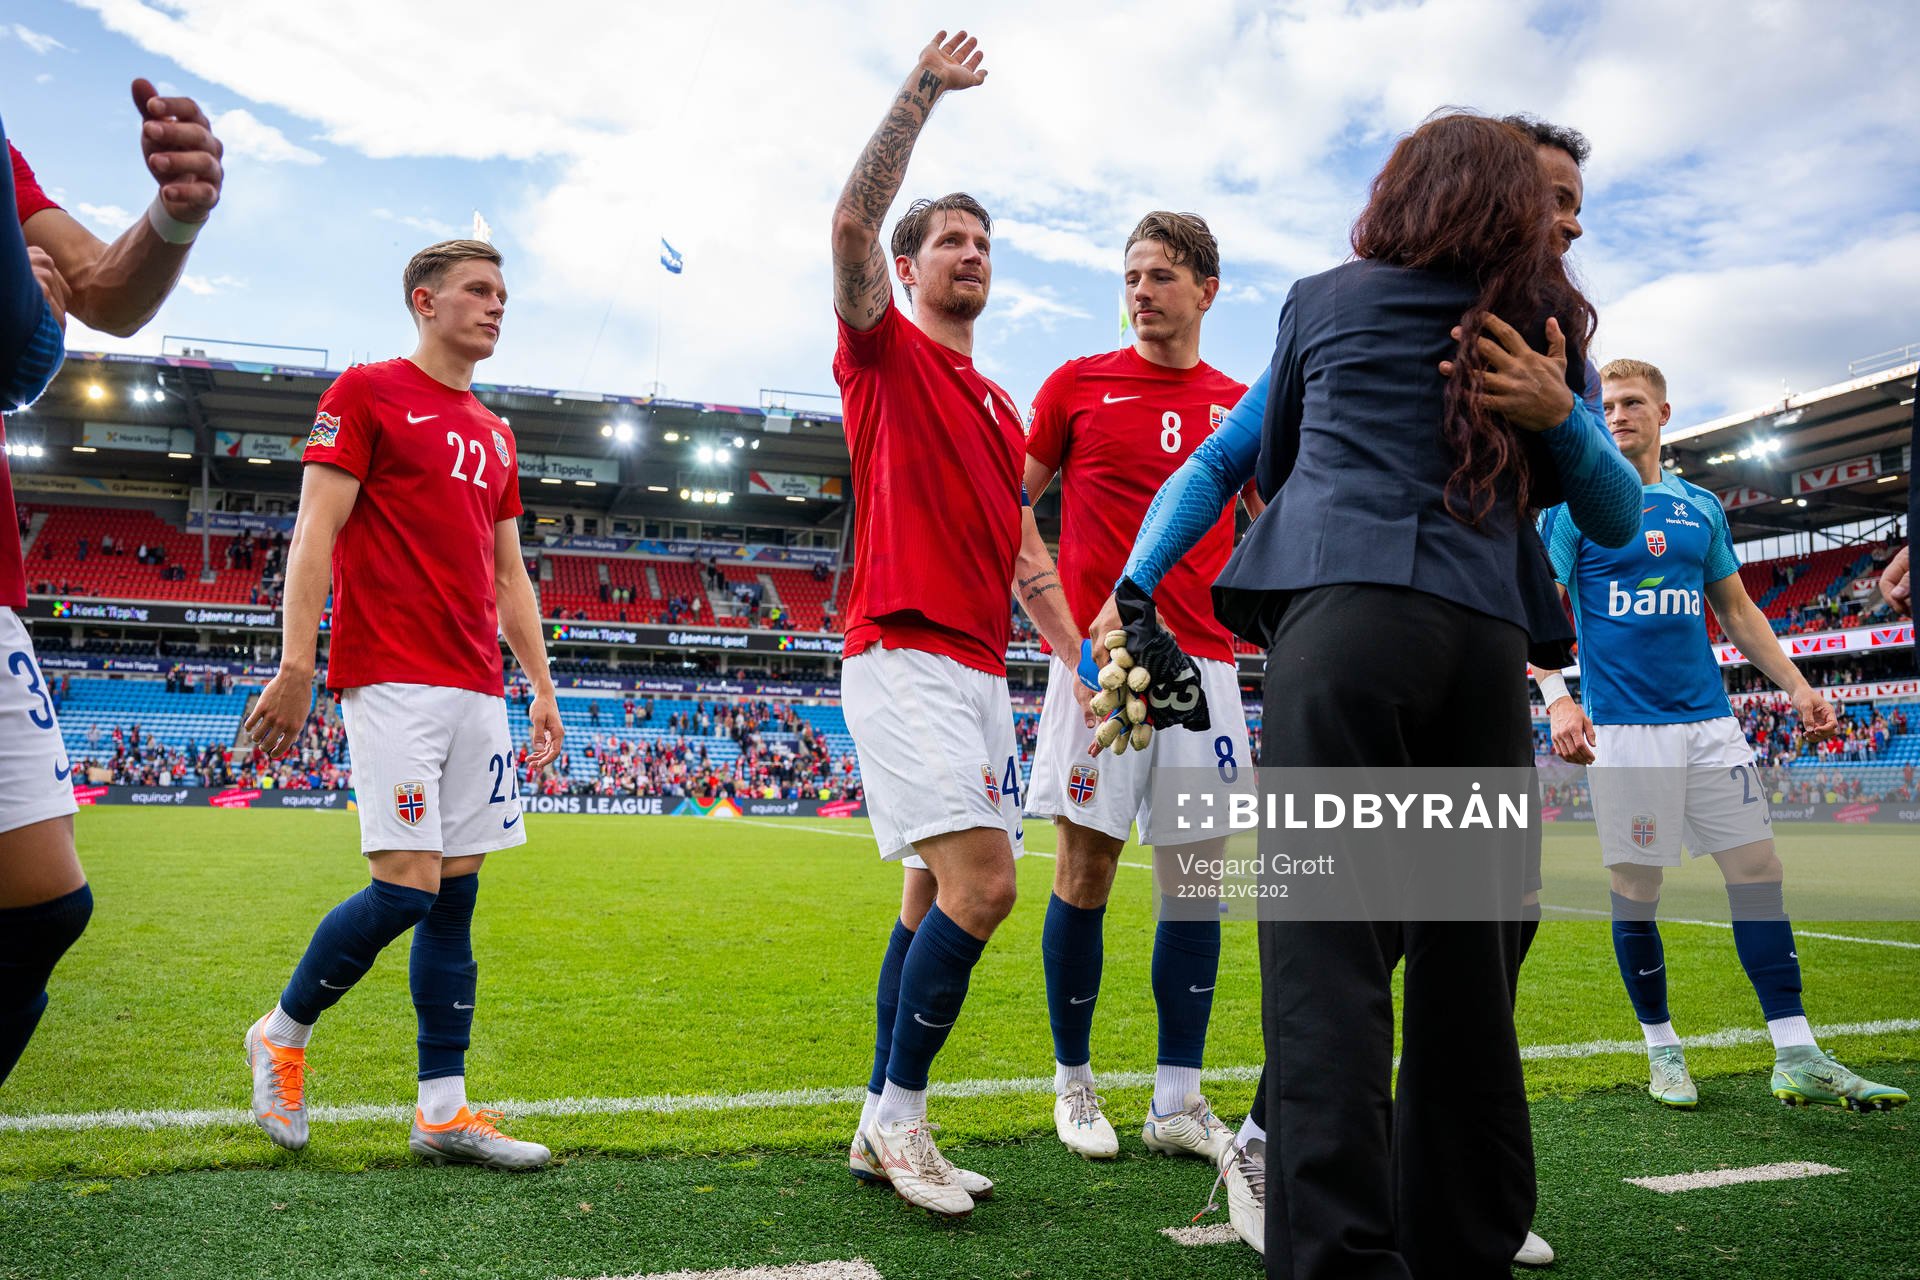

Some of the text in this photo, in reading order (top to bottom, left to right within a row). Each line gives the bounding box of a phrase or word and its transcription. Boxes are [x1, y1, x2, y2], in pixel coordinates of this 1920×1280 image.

[1160, 411, 1183, 453] 8
[446, 431, 488, 489] 22
[518, 460, 593, 478] Norsk Tipping
[1801, 459, 1872, 490] VG
[1681, 519, 1700, 528] Tipping
[1608, 581, 1700, 617] bama
[72, 604, 149, 621] Norsk Tipping
[570, 627, 637, 643] Norsk Tipping
[794, 638, 821, 650] Norsk
[1793, 635, 1847, 653] VG
[43, 658, 88, 669] Norsk Tipping
[114, 661, 159, 671] Norsk Tipping
[185, 664, 205, 672] Norsk
[8, 652, 54, 730] 3
[600, 680, 622, 689] Tipping
[662, 683, 683, 692] Tipping
[1877, 683, 1918, 696] VG
[781, 687, 803, 696] Tipping
[1832, 687, 1869, 699] VG
[1214, 735, 1239, 785] 8
[1002, 755, 1020, 808] 4
[1730, 762, 1766, 805] 2
[132, 793, 174, 804] equinor
[282, 795, 322, 807] equinor
[586, 798, 663, 814] LEAGUE
[751, 803, 787, 814] equinor
[1770, 809, 1804, 819] equinor
